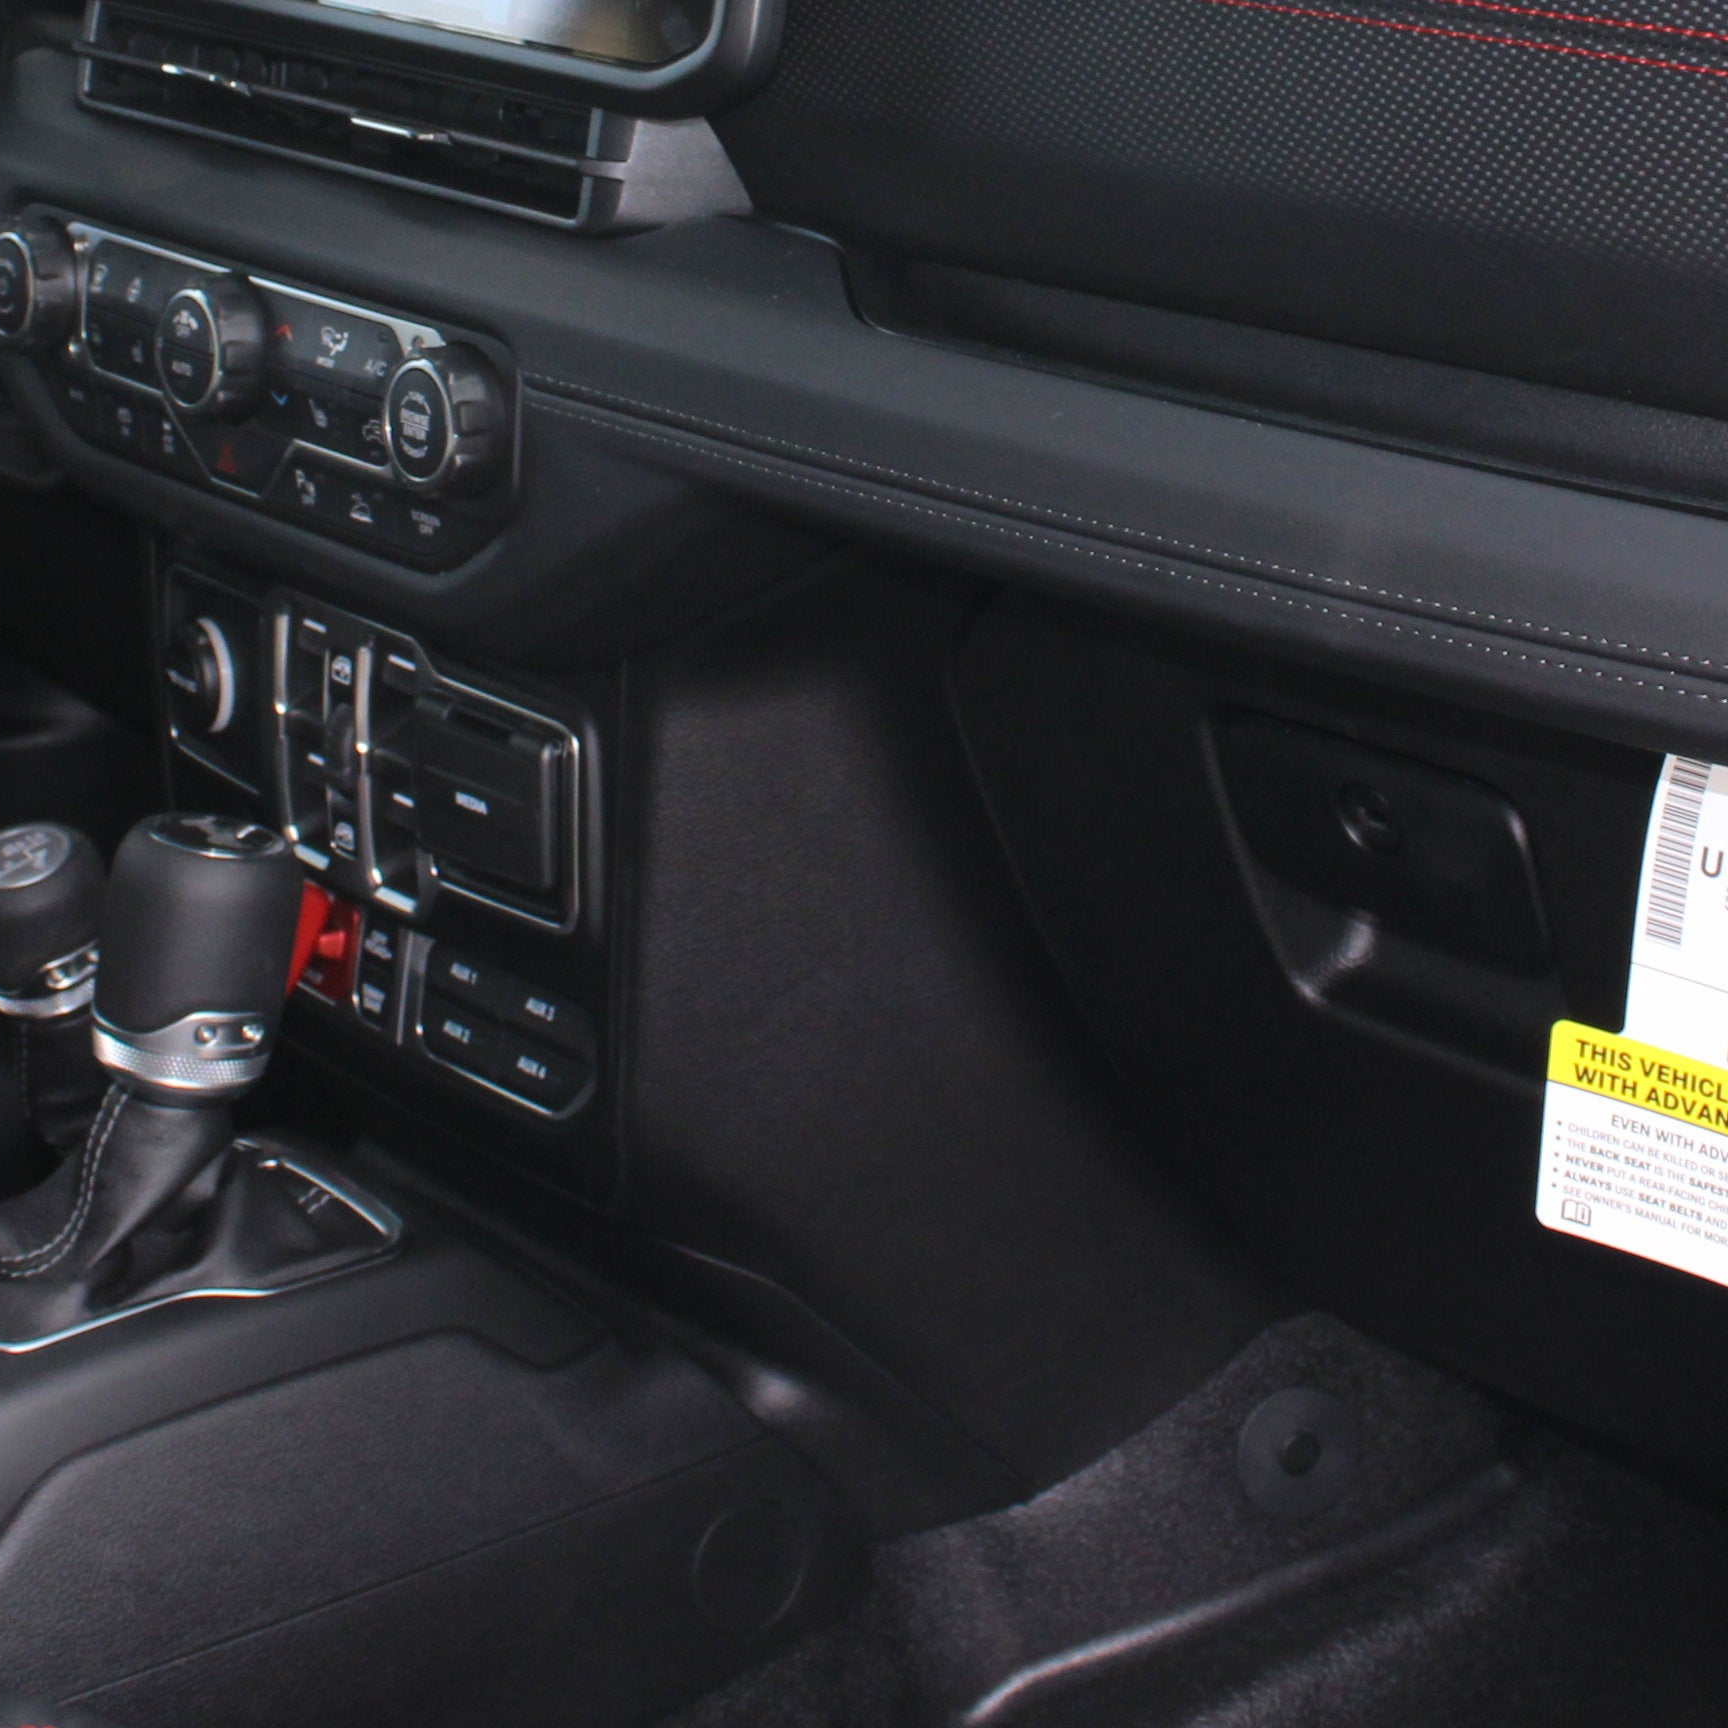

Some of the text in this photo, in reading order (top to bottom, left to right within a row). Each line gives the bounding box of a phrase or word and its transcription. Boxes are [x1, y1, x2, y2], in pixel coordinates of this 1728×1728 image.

[1701, 846, 1723, 878] U
[1576, 1038, 1631, 1071] THIS
[1574, 1063, 1636, 1098] WITH
[1568, 1123, 1619, 1145] CHILDREN
[1623, 1139, 1643, 1153] CAN
[1648, 1148, 1659, 1158] BE
[1664, 1153, 1696, 1170] KILLED
[1701, 1165, 1714, 1177] OR
[1612, 1114, 1649, 1137] EVEN
[1656, 1129, 1692, 1151] WITH
[1566, 1155, 1602, 1171] NEVER
[1607, 1167, 1625, 1179] PUT
[1629, 1174, 1635, 1182] A
[1640, 1177, 1704, 1205] REAR-FACING
[1568, 1139, 1585, 1150] THE
[1591, 1146, 1619, 1161] BACK
[1624, 1156, 1650, 1171] SEAT
[1655, 1166, 1662, 1175] IS
[1668, 1170, 1685, 1182] THE
[1690, 1177, 1728, 1198] SAFEST
[1563, 1185, 1580, 1197] SEE
[1585, 1192, 1630, 1213] OWNER'S
[1636, 1208, 1677, 1229] MANUAL
[1682, 1223, 1700, 1237] FOR
[1564, 1170, 1611, 1190] ALWAYS
[1616, 1185, 1634, 1198] USE
[1639, 1193, 1665, 1208] SEAT
[1670, 1203, 1701, 1220] BELTS
[1706, 1215, 1726, 1229] AND
